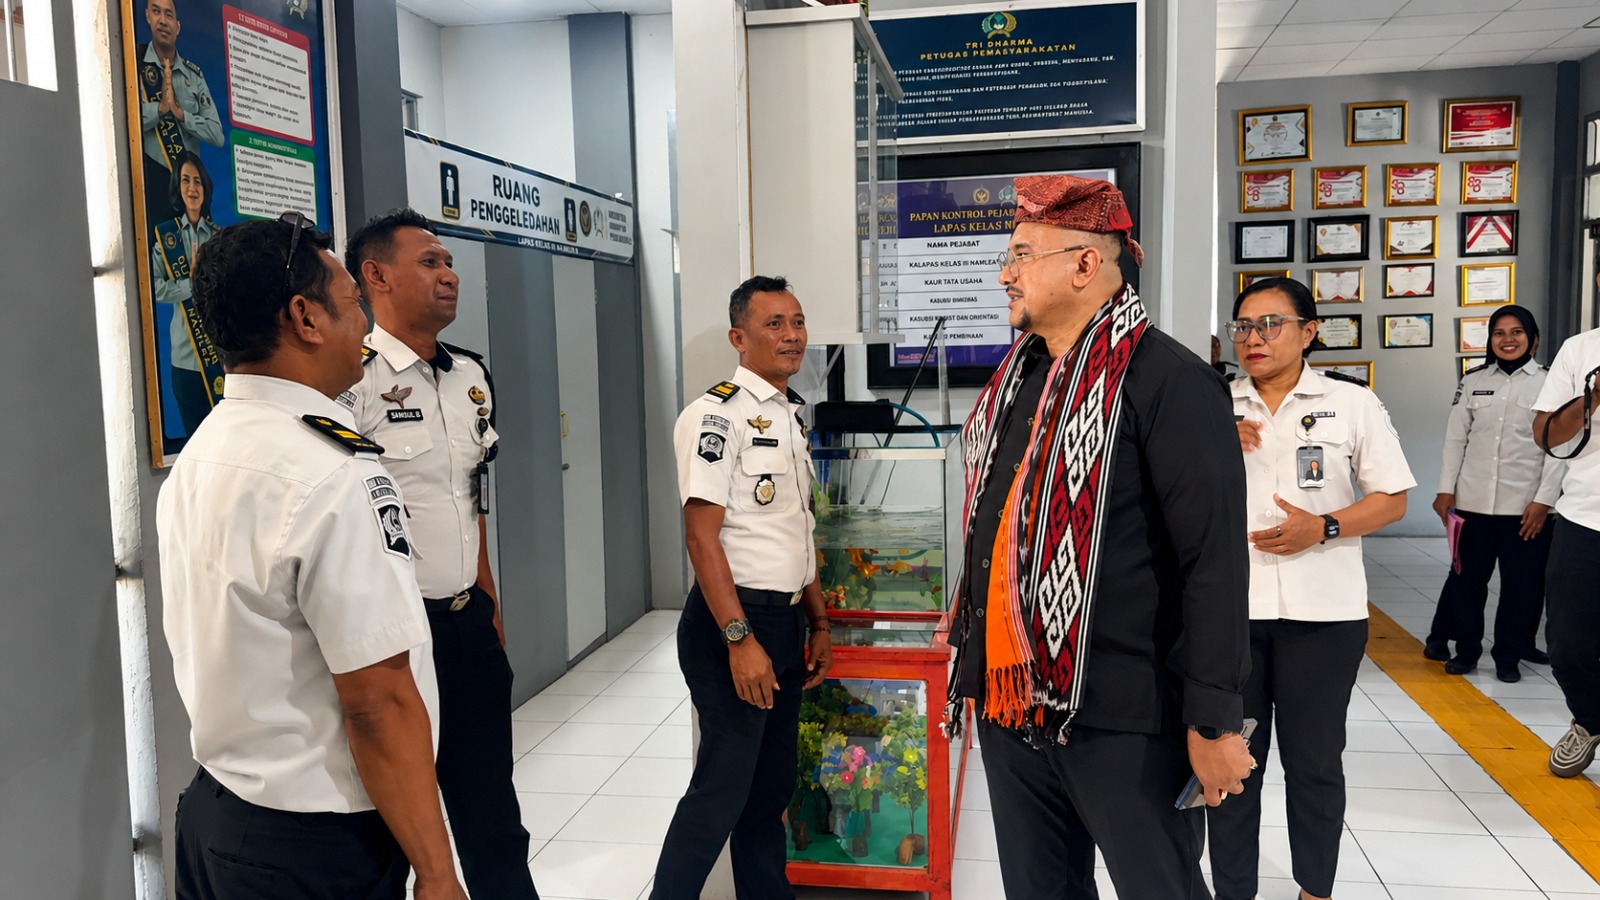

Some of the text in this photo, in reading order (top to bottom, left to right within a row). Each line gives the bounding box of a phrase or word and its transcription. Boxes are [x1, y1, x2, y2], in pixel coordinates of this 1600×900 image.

[987, 38, 1033, 48] DHARMA
[920, 43, 1076, 60] PETUGAS PEMASYARAKATAN
[491, 174, 541, 208] RUANG
[470, 198, 560, 236] PENGGELEDAHAN
[909, 212, 939, 222] PAPAN
[941, 209, 986, 220] KONTROL
[934, 223, 966, 233] LAPAS
[969, 221, 1002, 232] KELAS
[927, 240, 980, 249] NAMA PEJABAT
